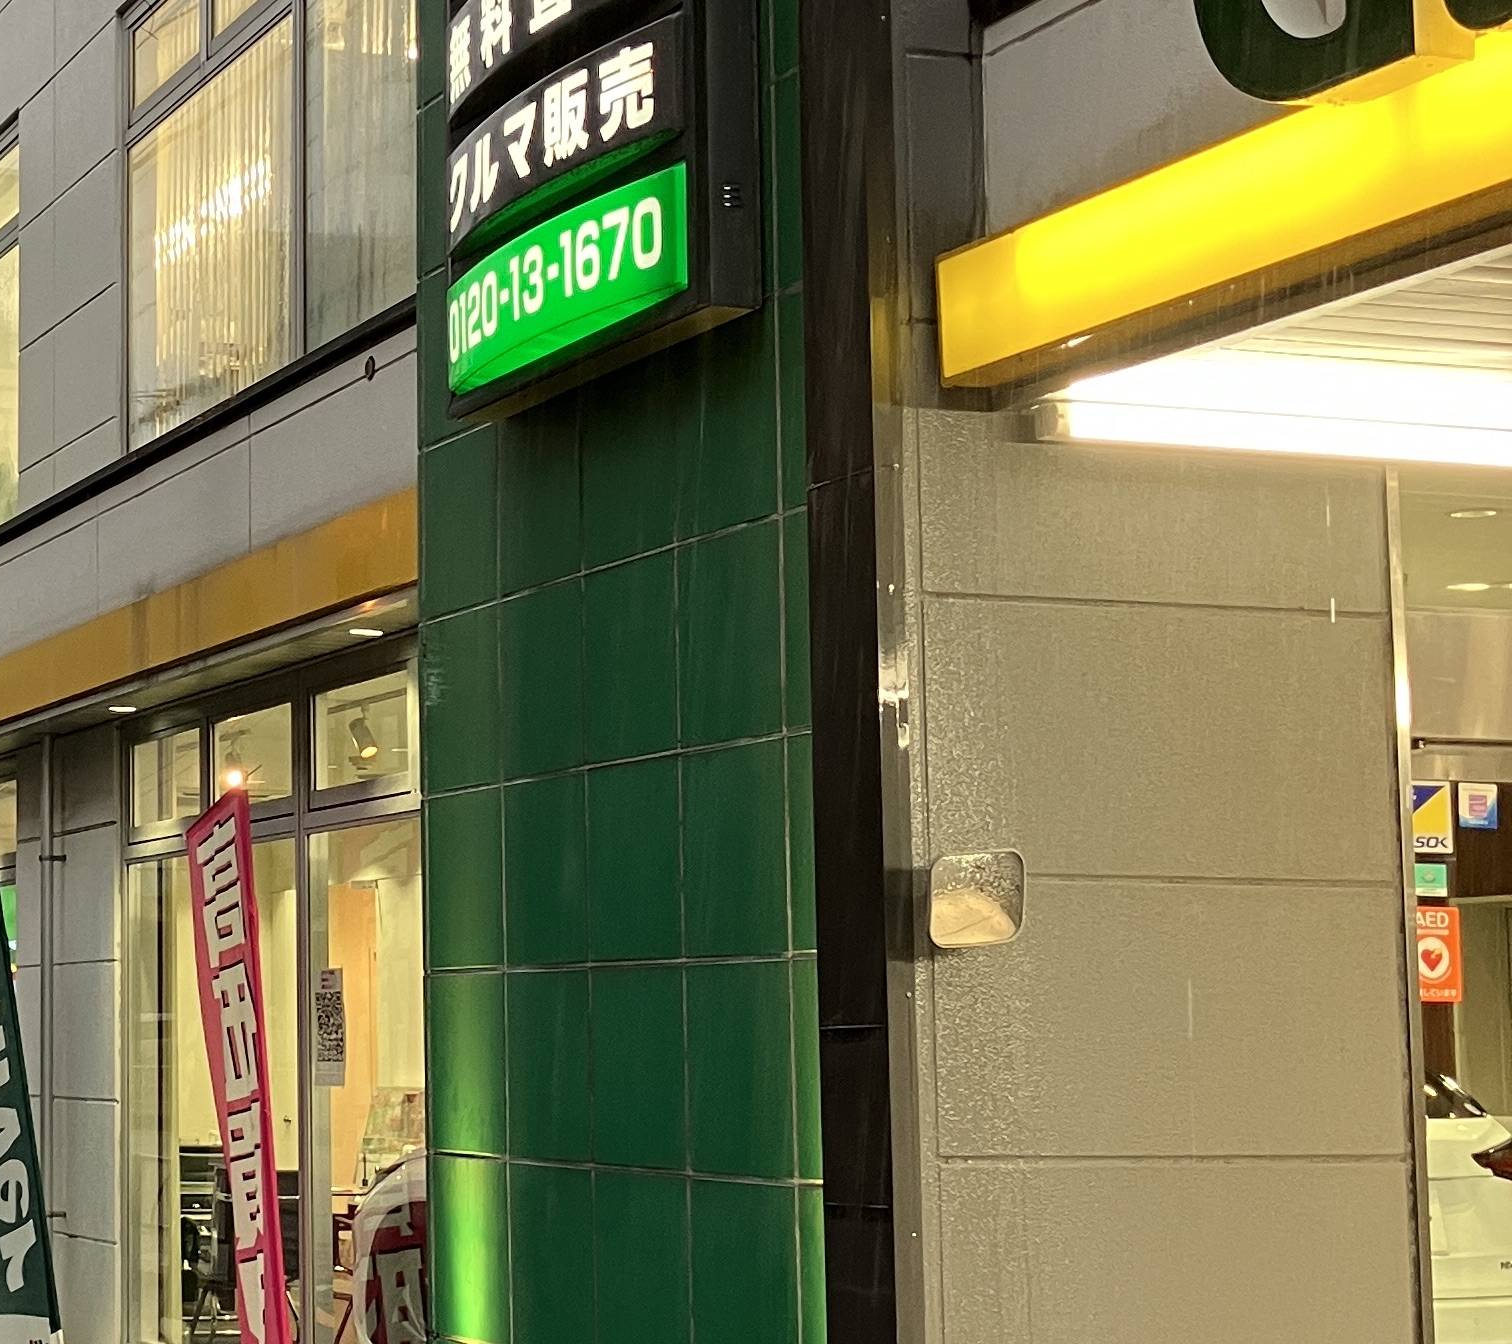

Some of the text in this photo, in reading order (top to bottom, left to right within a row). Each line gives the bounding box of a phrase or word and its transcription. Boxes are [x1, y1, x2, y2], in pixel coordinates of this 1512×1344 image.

[446, 41, 656, 234] クルマ販売
[449, 195, 663, 364] 0120-13-1670
[1416, 911, 1449, 928] AED
